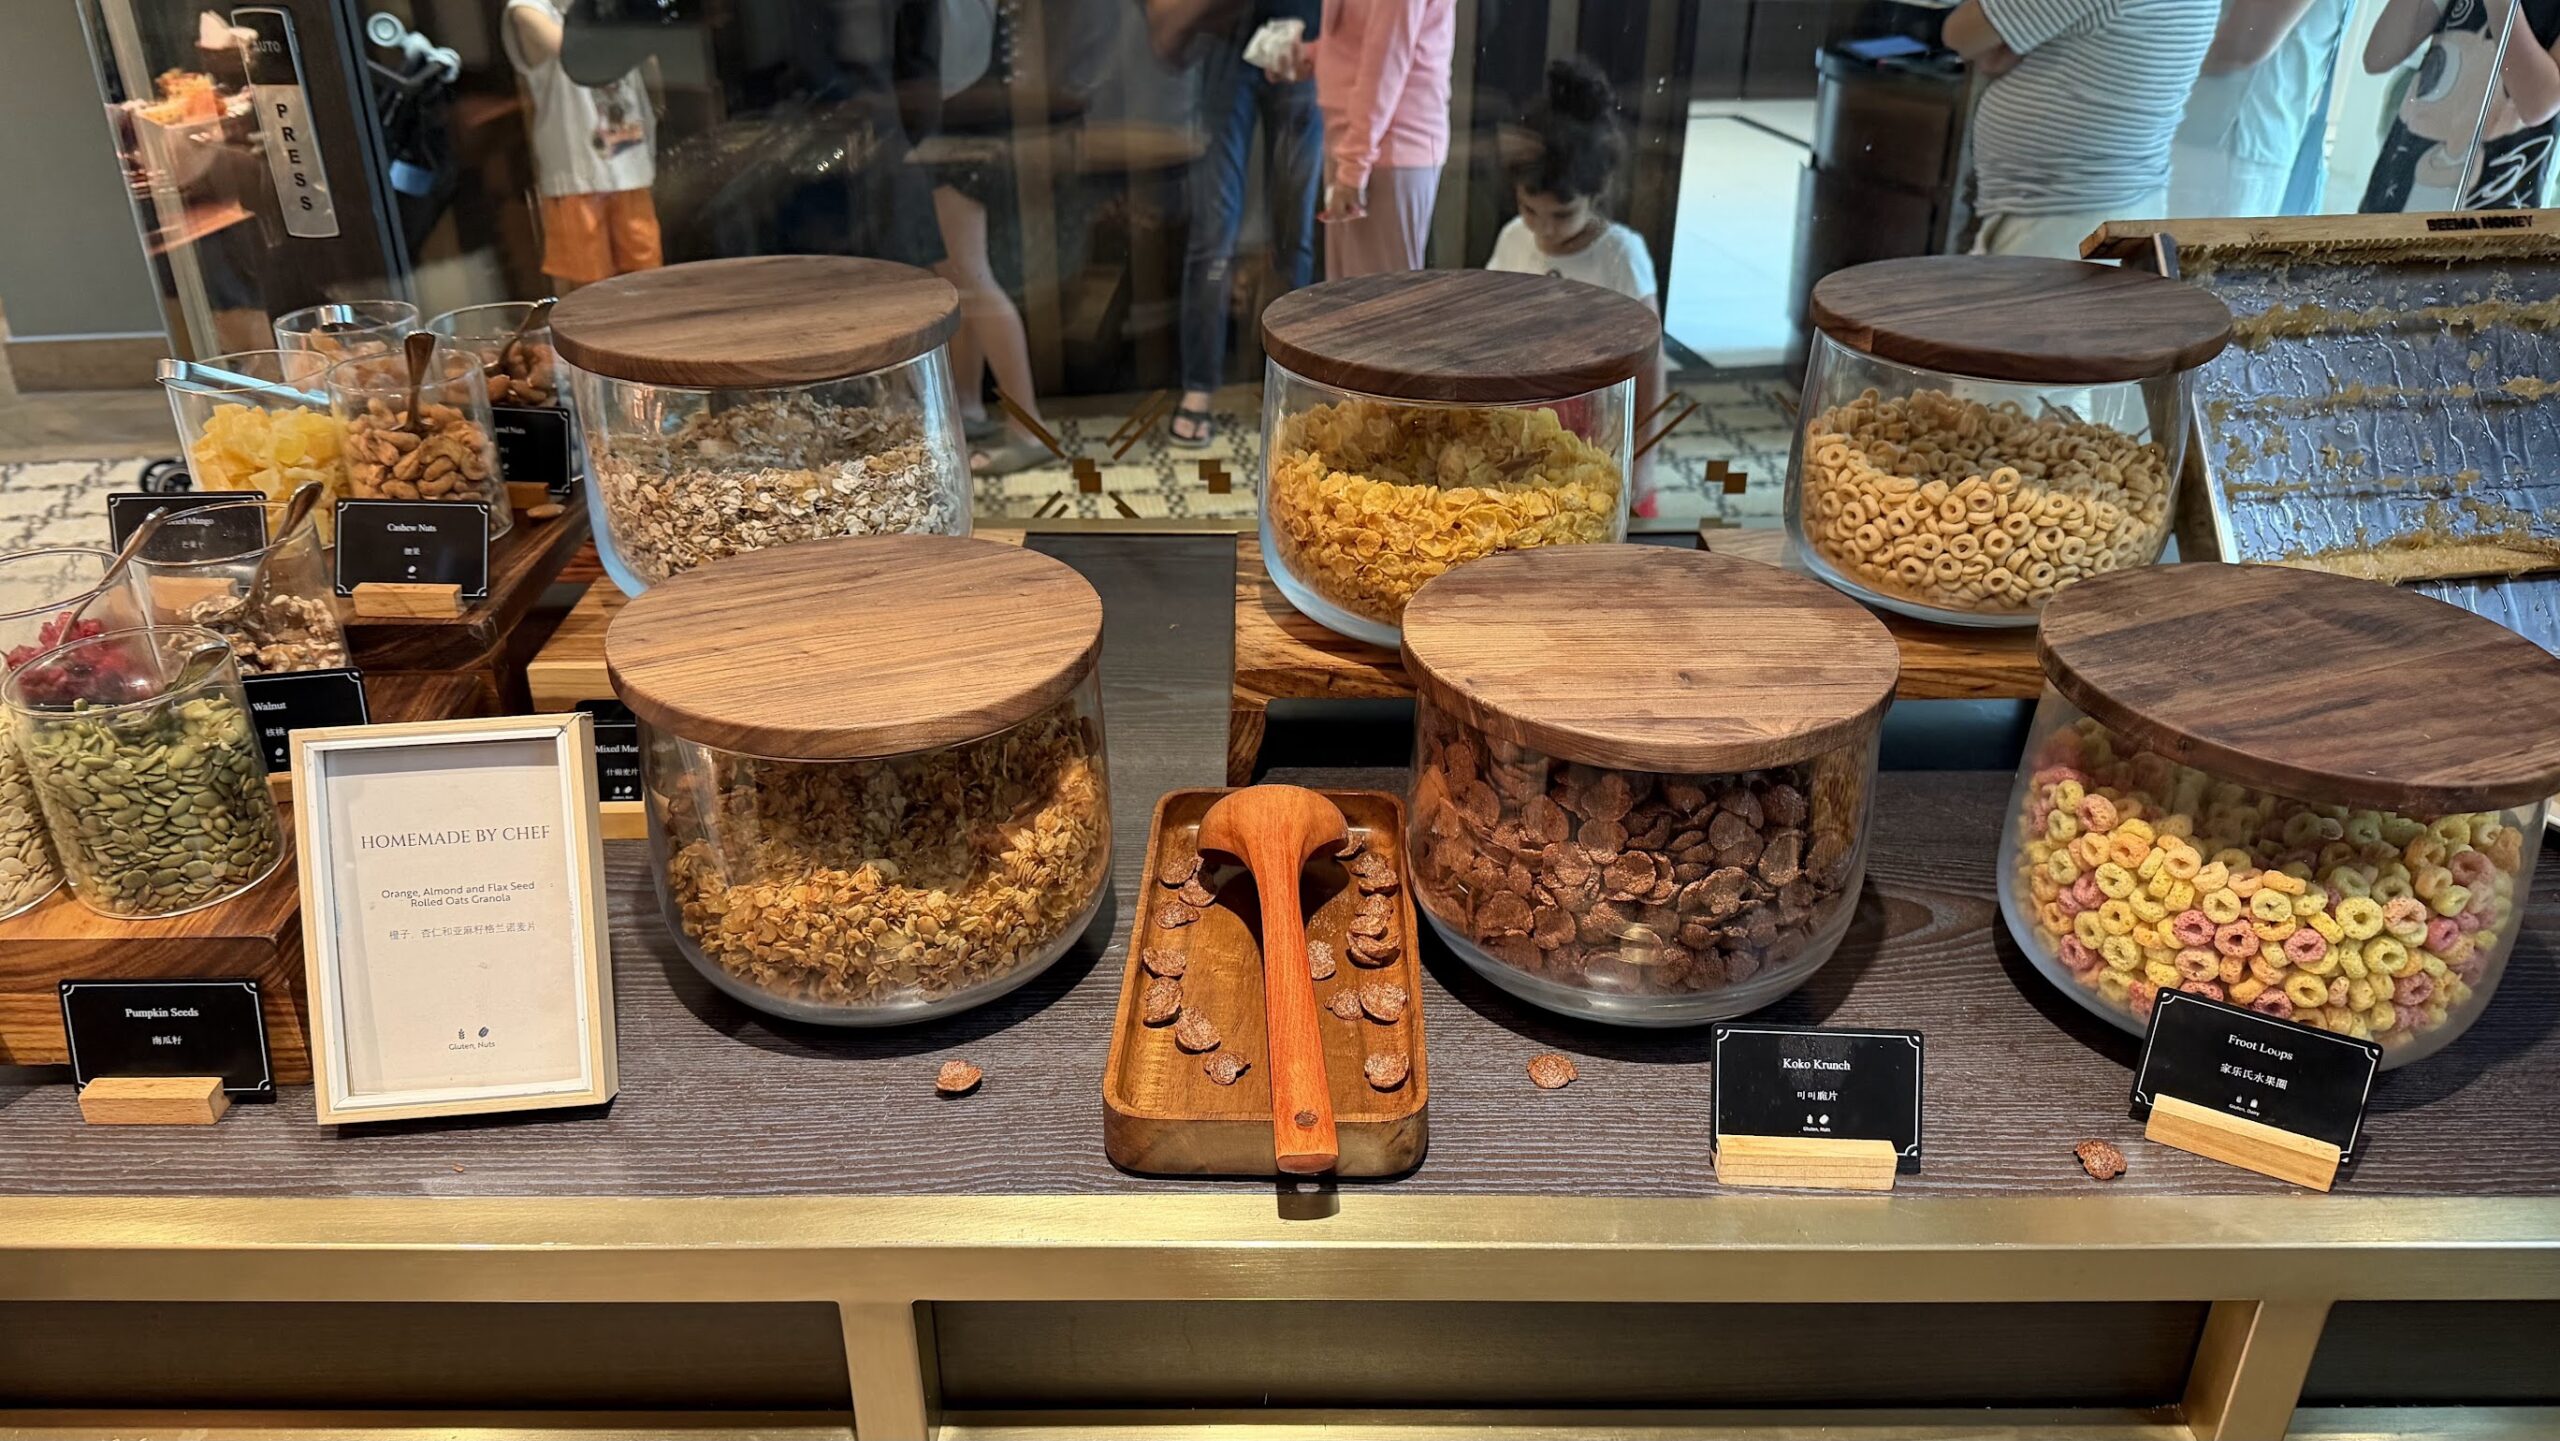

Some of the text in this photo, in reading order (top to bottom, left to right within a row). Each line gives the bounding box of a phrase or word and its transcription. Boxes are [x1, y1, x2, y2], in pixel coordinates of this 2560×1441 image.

[276, 103, 313, 211] PRESS
[2480, 215, 2533, 229] HONEY
[187, 517, 215, 527] Mango
[387, 523, 437, 532] Cashew Nuts
[252, 702, 287, 711] Walnut
[595, 745, 620, 753] Mixed
[361, 825, 550, 849] HOMEMADE BY CHEF
[381, 881, 535, 899] Orange, Almond and Flax Seed
[411, 894, 511, 907] Rolled Oats Granola
[125, 1007, 199, 1019] Pumpkin Seeds
[2228, 1034, 2293, 1061] Froot Loops
[1783, 1058, 1851, 1071] Koko Krunch
